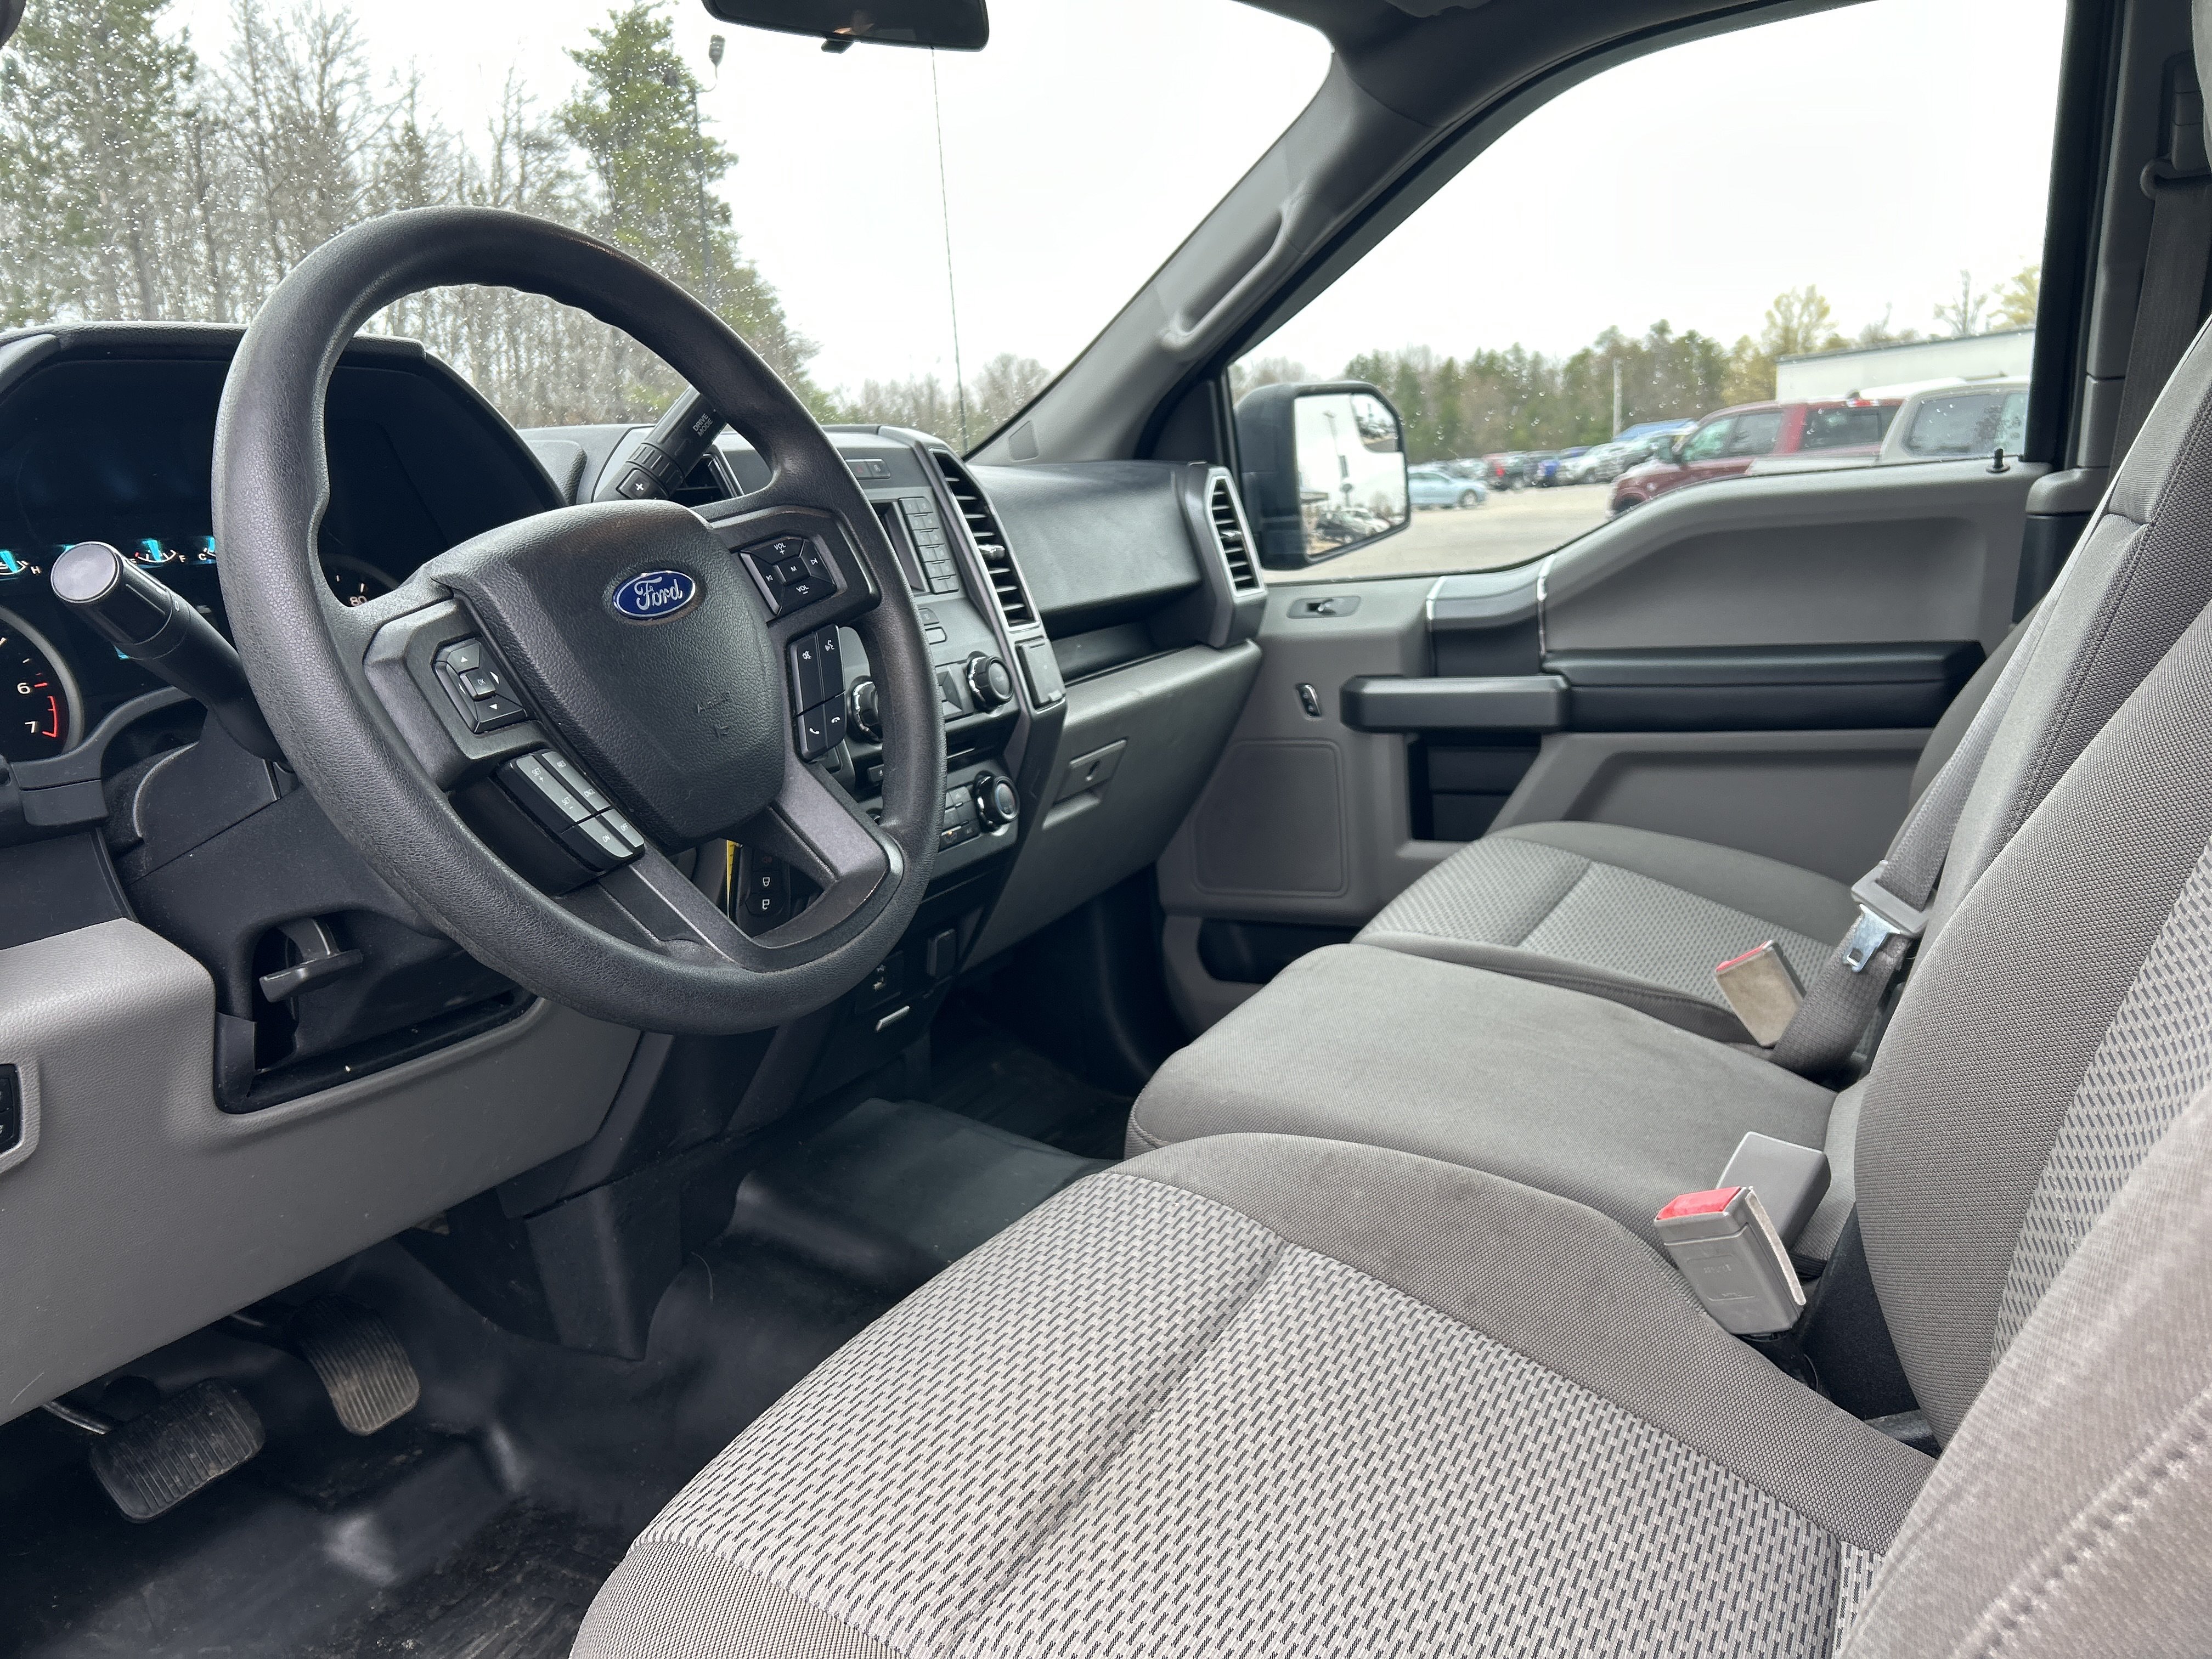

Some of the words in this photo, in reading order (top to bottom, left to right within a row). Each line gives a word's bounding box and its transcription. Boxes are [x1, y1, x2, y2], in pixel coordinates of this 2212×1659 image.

[692, 413, 709, 432] DRIVE
[697, 418, 713, 437] MODE
[774, 542, 787, 550] VOL
[179, 555, 186, 563] F
[30, 566, 41, 574] H
[634, 576, 683, 611] Ford
[17, 682, 31, 695] 6
[24, 721, 36, 733] 7
[532, 768, 541, 777] SET
[561, 796, 571, 806] SET
[602, 834, 611, 843] ON
